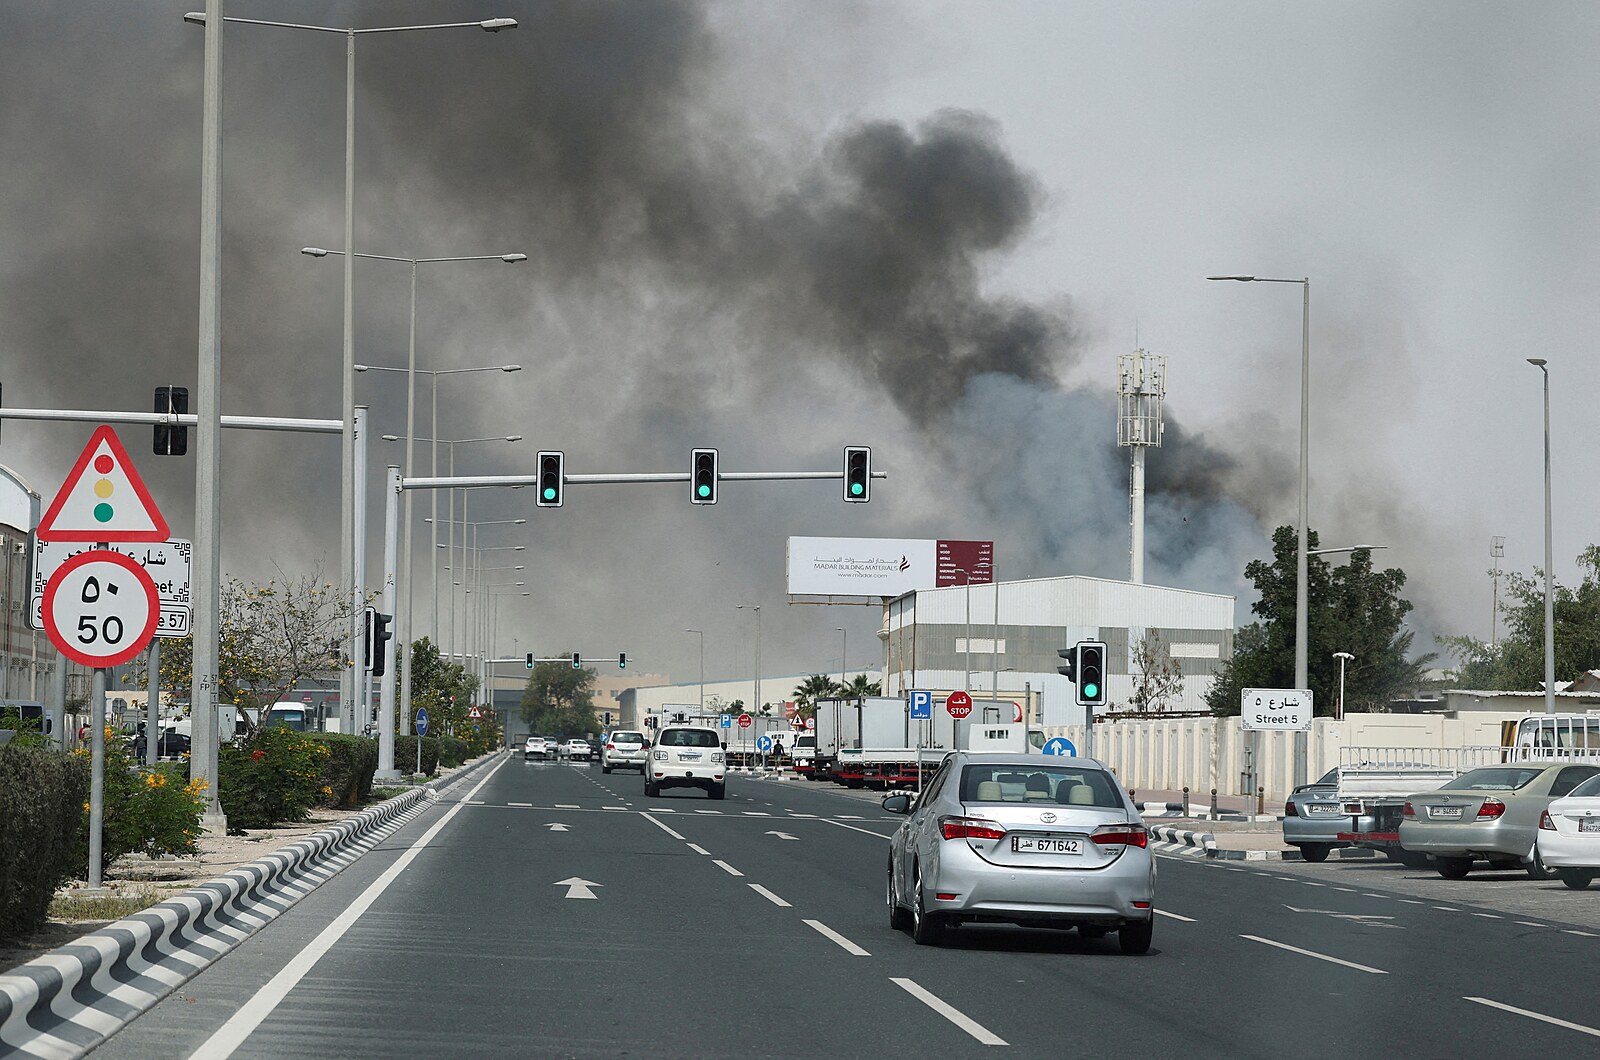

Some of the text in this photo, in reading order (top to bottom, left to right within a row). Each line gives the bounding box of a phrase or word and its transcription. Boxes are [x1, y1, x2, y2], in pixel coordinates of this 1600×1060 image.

[170, 614, 184, 628] 57
[77, 616, 124, 644] 50
[914, 693, 928, 710] P
[952, 696, 966, 704] قف
[1269, 697, 1300, 710] شارع
[1256, 714, 1298, 724] Street 5
[1038, 840, 1078, 852] 671642
